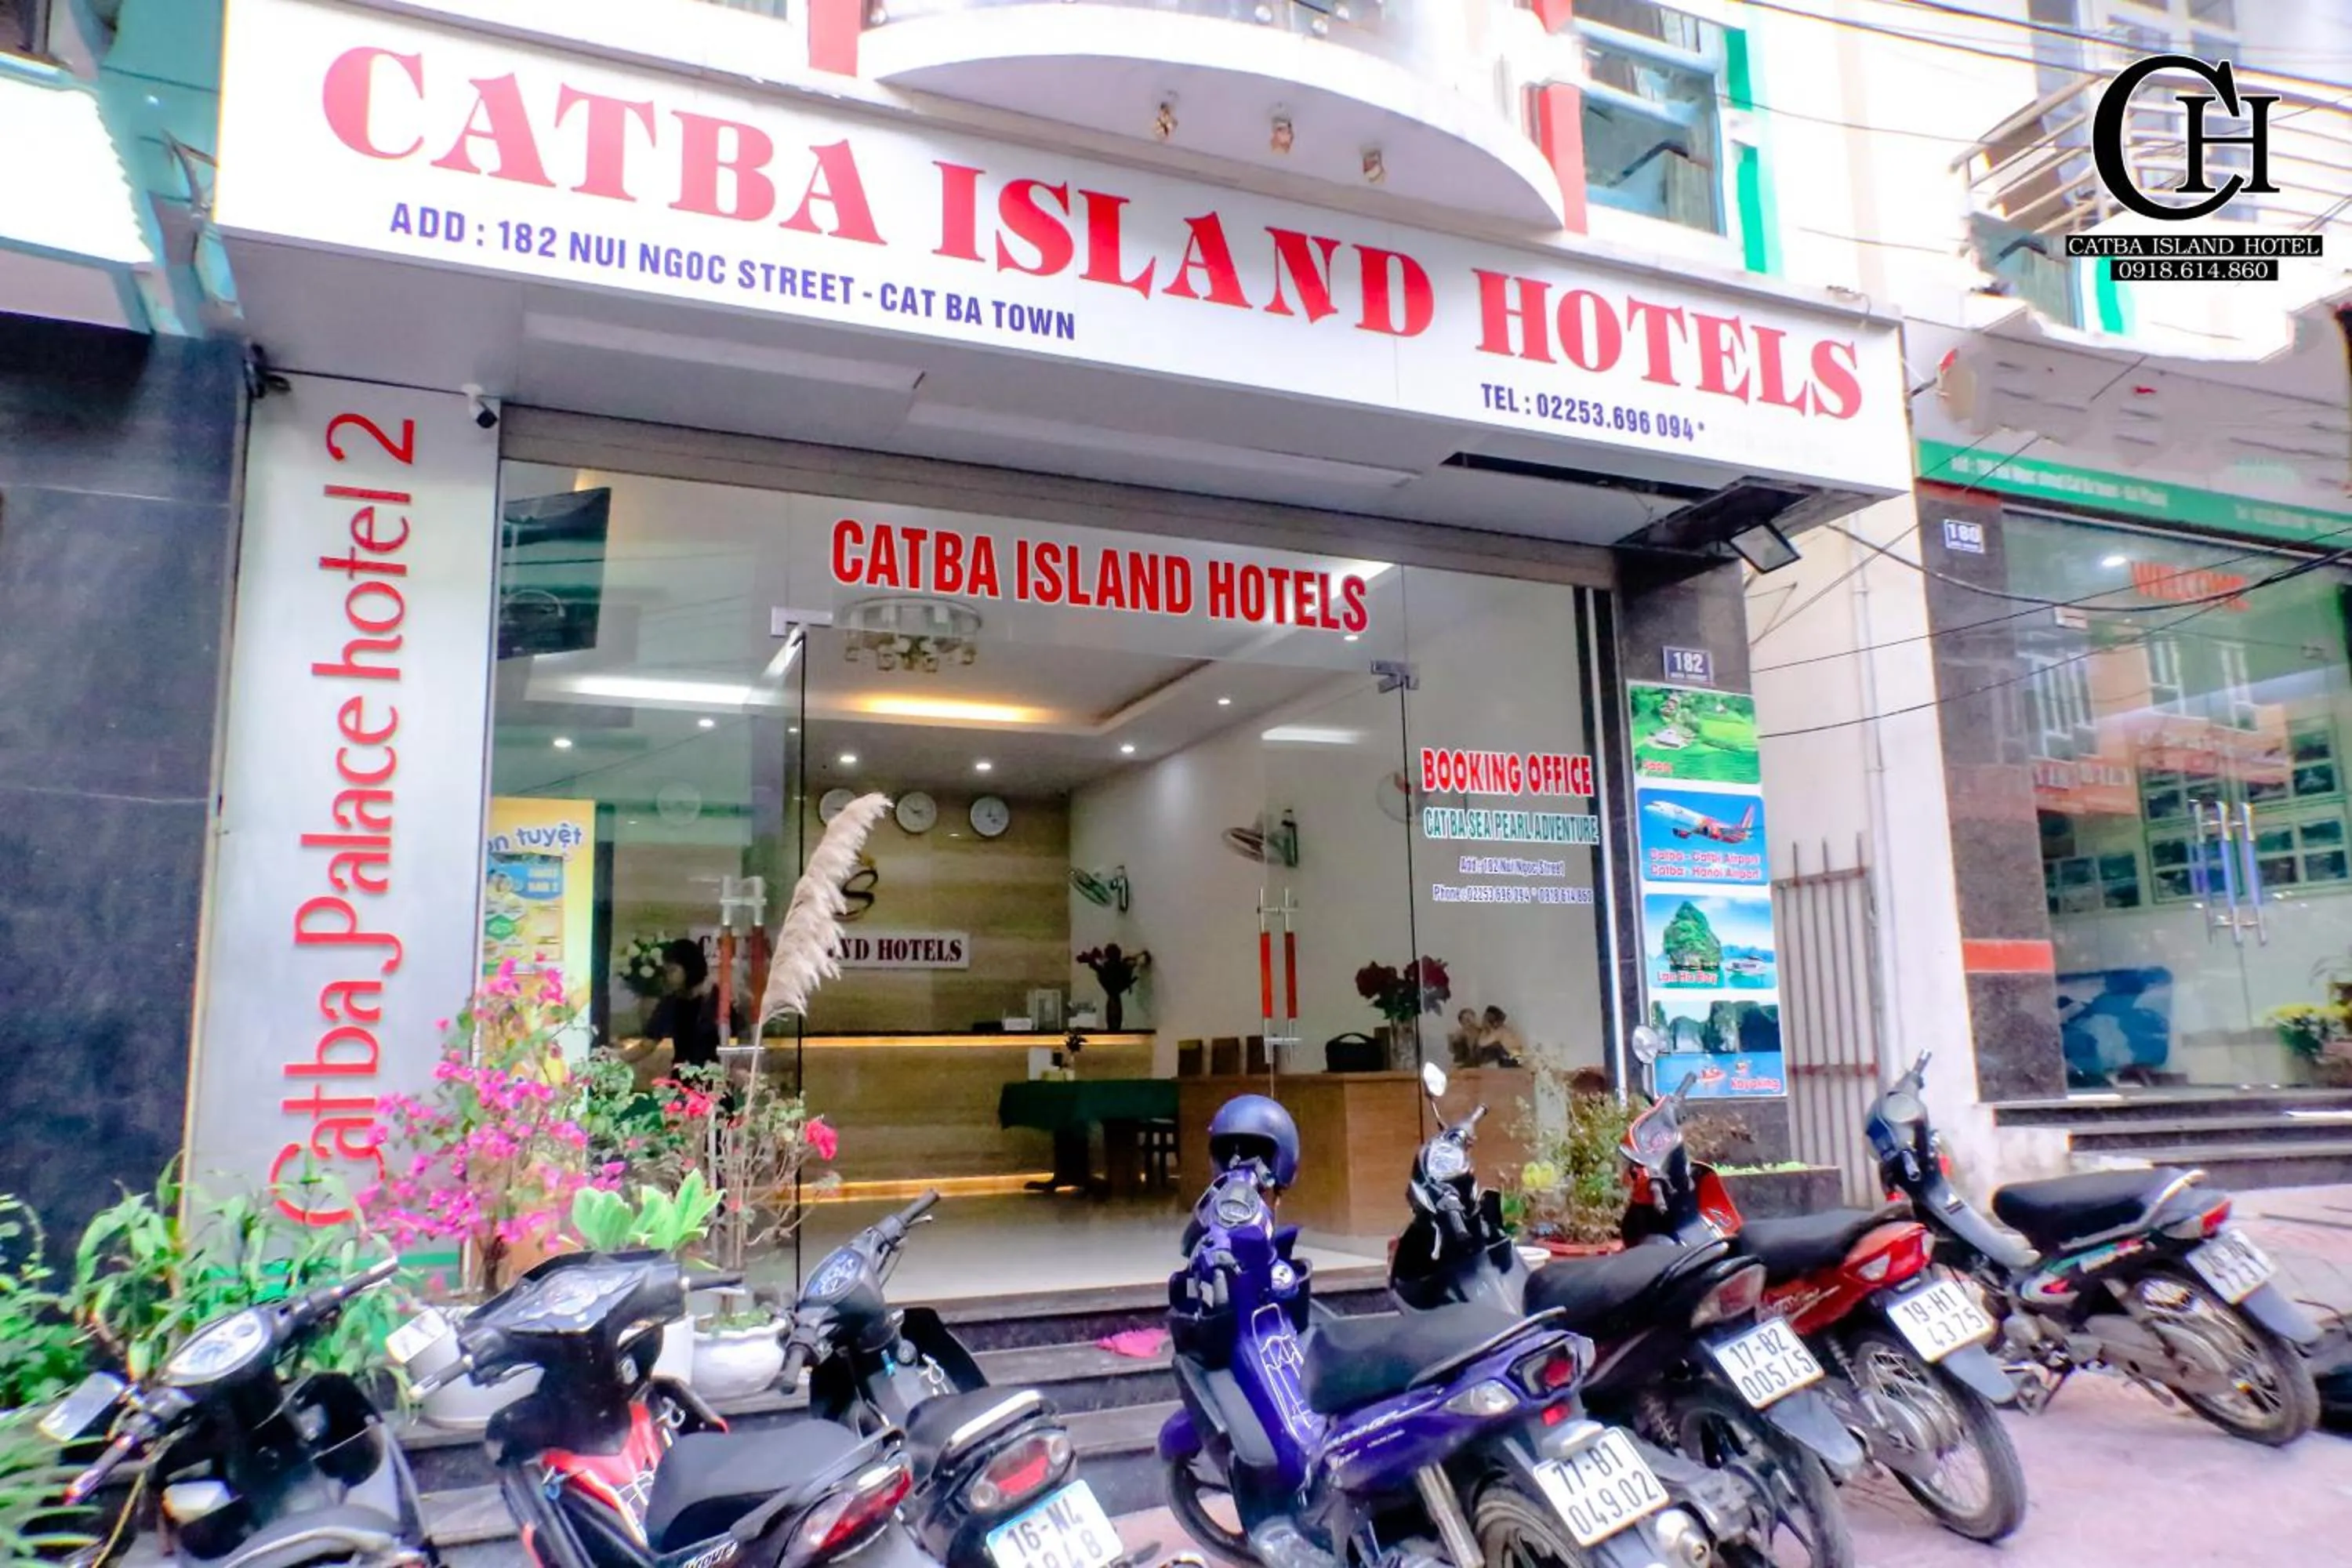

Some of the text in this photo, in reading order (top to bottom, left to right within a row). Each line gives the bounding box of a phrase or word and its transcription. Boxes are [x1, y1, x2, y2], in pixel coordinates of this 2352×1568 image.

[321, 45, 1863, 420] CATBA ISLAND HOTELS
[497, 220, 557, 259] 182
[568, 231, 626, 269] NUI
[638, 242, 726, 285] NGOC
[945, 292, 982, 326] BA
[991, 300, 1076, 340] TOWN
[1536, 393, 1651, 434] 02253.696
[325, 412, 416, 466] 2
[310, 484, 412, 681] hotel
[831, 518, 1370, 633] CATBA ISLAND HOTELS
[1672, 651, 1704, 674] 182
[1421, 749, 1592, 796] BOOKING OFFICE
[293, 695, 403, 975] Palace
[517, 823, 582, 848] tuyệt
[1468, 811, 1491, 839] SEA
[1494, 812, 1531, 840] PEARL
[1535, 814, 1598, 844] ADVENTURE
[877, 938, 962, 962] HOTELS
[1902, 1287, 1958, 1325] 19-H1
[1729, 1327, 1790, 1370] 17-B2
[1568, 1470, 1658, 1535] 049.02
